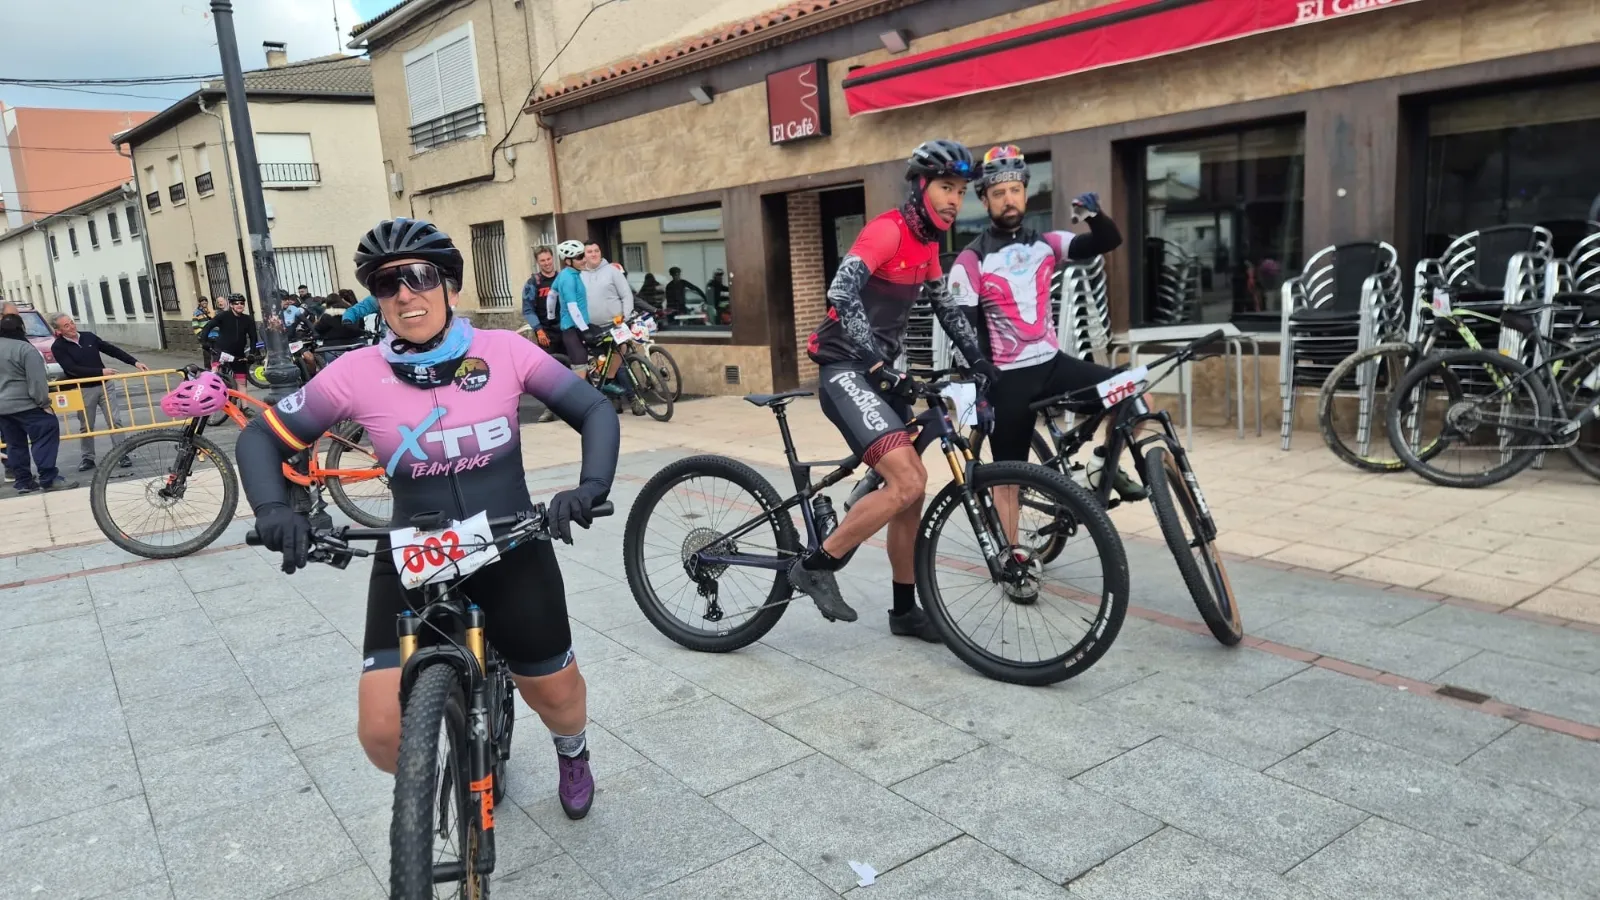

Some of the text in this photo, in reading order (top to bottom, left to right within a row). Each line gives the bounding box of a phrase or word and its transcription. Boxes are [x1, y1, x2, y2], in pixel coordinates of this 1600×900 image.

[1295, 0, 1325, 24] El
[772, 117, 814, 142] El Café
[456, 373, 487, 392] XTB
[386, 406, 512, 477] XTB
[410, 453, 493, 479] TEAM BIKE
[924, 495, 952, 539] MAXXIS
[403, 530, 465, 573] 002
